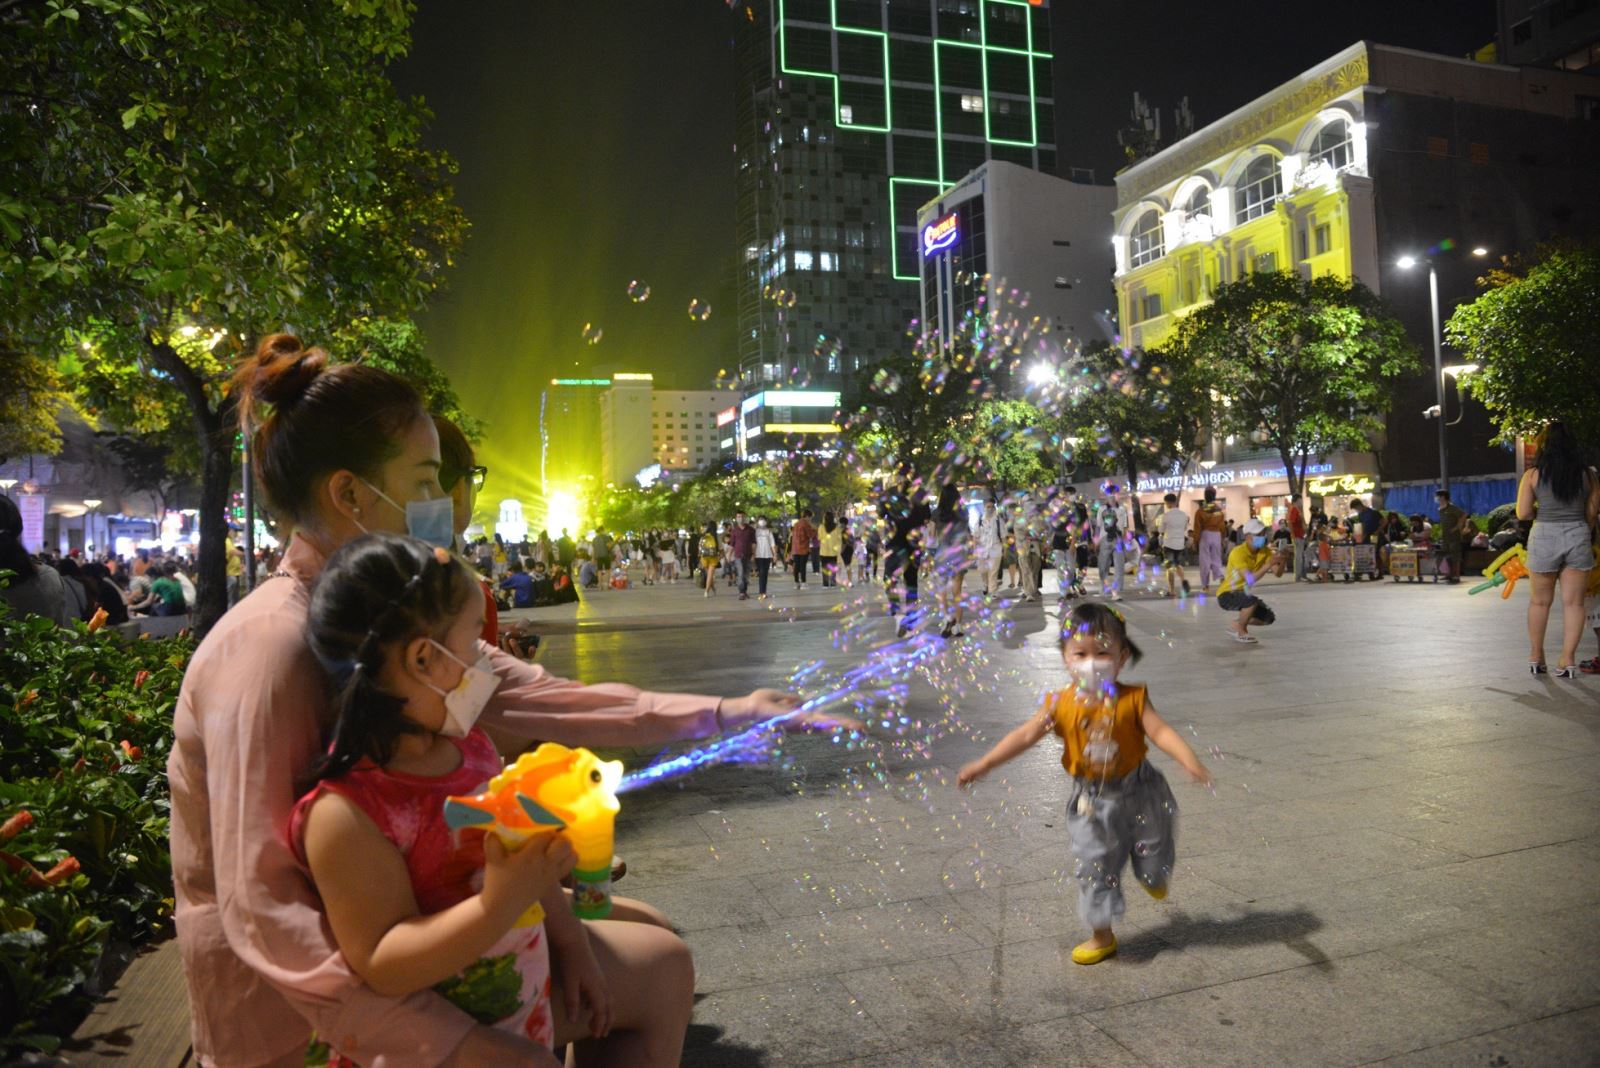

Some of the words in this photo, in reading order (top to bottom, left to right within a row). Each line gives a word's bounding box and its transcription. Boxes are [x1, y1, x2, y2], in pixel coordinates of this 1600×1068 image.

[1126, 479, 1156, 492] RYAL
[1158, 476, 1192, 488] HOTEL
[1192, 471, 1235, 484] SAIGON
